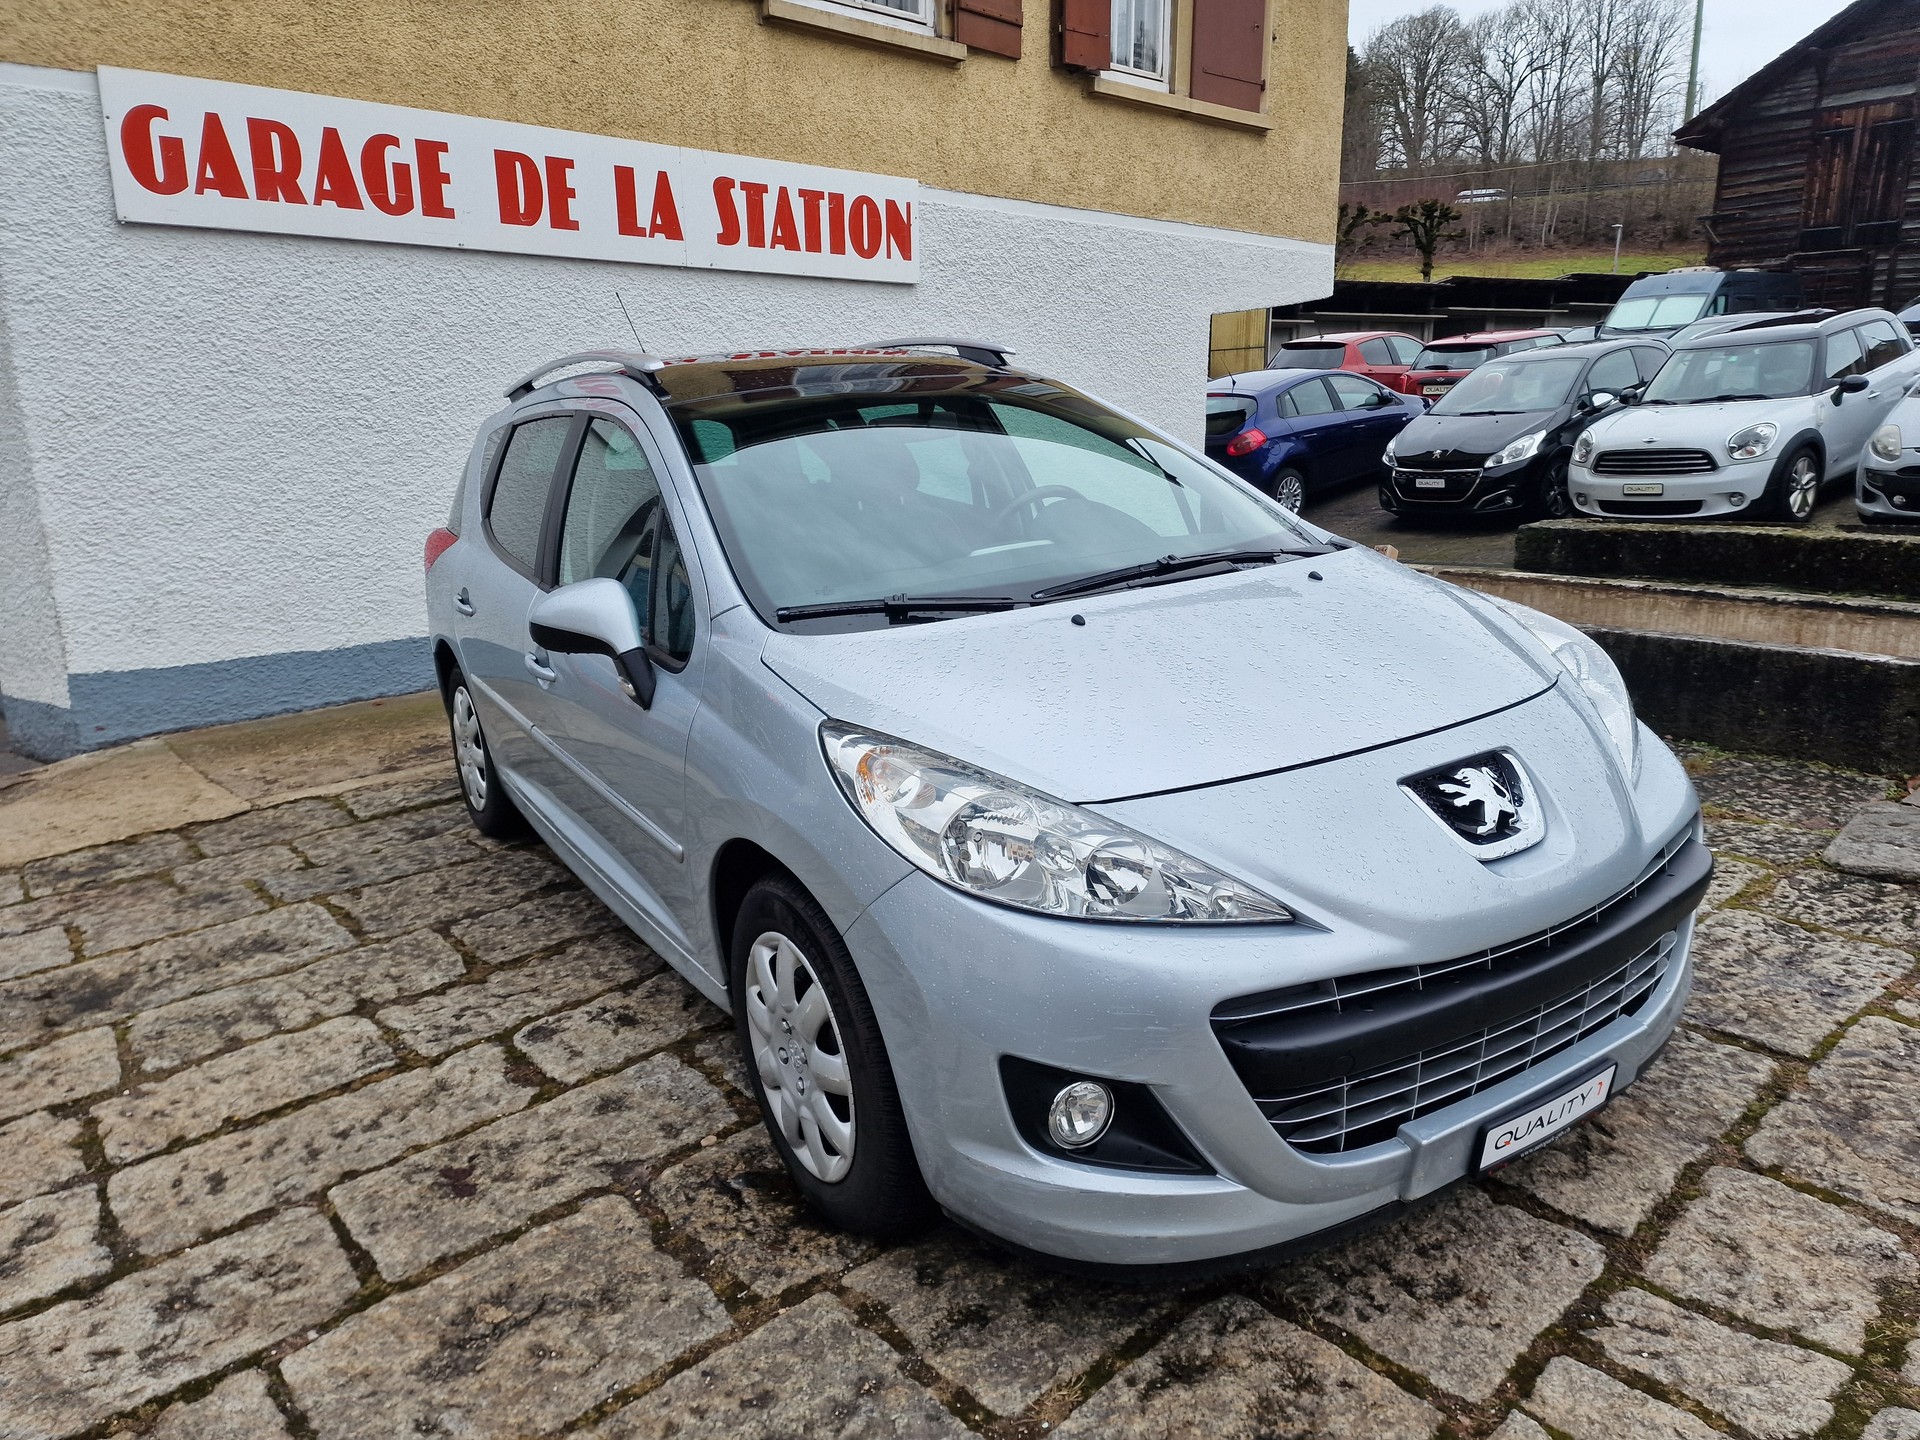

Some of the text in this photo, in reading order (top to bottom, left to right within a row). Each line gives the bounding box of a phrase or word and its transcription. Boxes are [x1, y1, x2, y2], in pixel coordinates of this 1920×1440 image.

[121, 104, 913, 261] GARAGE DE LA STATION
